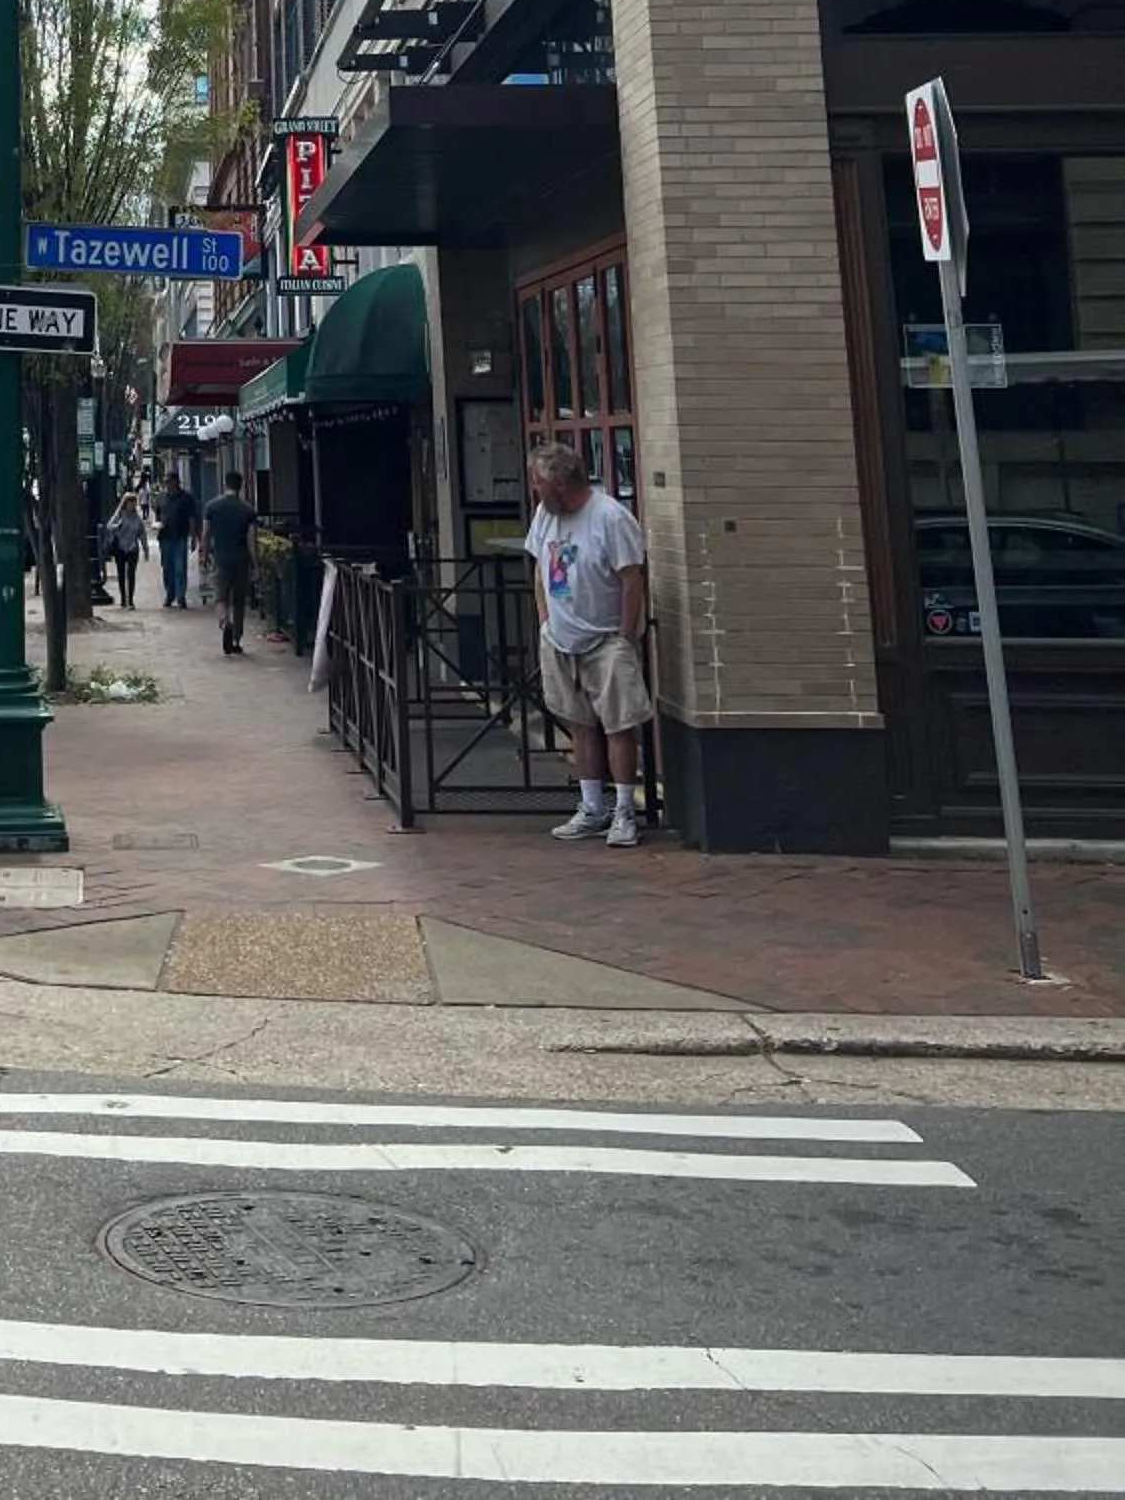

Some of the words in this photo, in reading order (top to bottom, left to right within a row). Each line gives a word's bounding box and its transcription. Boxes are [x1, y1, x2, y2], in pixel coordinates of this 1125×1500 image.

[296, 141, 322, 270] PIA
[54, 230, 188, 269] Tazewell
[202, 237, 217, 253] St
[202, 255, 229, 273] 100
[29, 310, 76, 335] WAY
